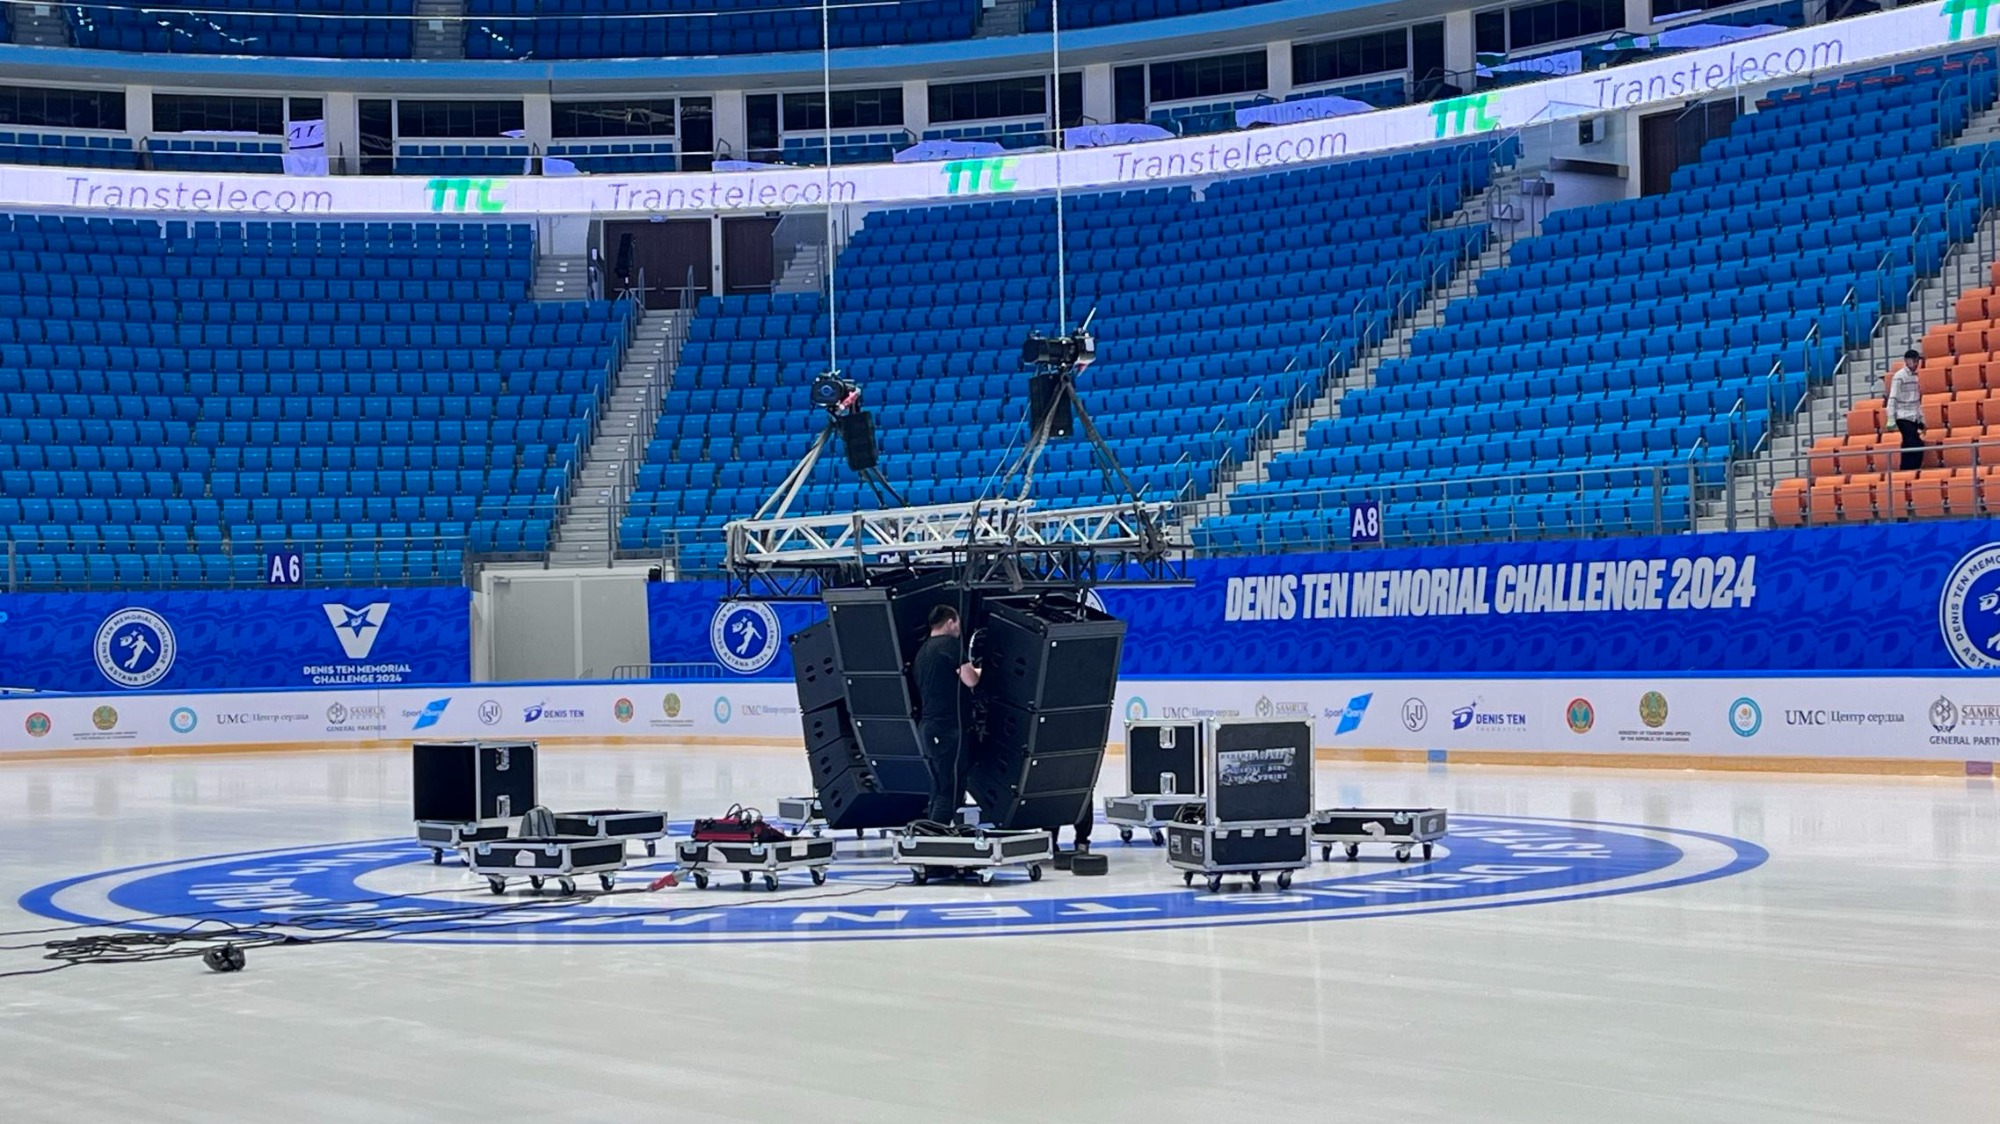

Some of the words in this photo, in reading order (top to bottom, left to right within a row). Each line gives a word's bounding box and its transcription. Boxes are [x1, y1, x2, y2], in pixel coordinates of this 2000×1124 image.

[1595, 40, 1844, 107] Transtelecom
[1113, 131, 1347, 181] Transtelecom
[66, 177, 333, 211] Transtelecom
[608, 179, 856, 211] Transtelecom
[1352, 508, 1378, 537] A8
[271, 555, 300, 582] A6
[1225, 574, 1297, 621] DENIS
[1302, 572, 1349, 619] TEN
[1351, 567, 1489, 618] MEMORIAL
[1494, 559, 1667, 614] CHALLENGE
[1667, 555, 1756, 609] 2024
[1954, 575, 1969, 598] TEN
[1952, 603, 1965, 642] DENIS
[303, 665, 335, 675] DENIS
[336, 665, 355, 674] TEN
[357, 664, 412, 674] MEMORIAL
[313, 674, 374, 684] CHALLENGE
[376, 674, 402, 683] 2024
[216, 713, 249, 724] UMC
[544, 710, 567, 718] DENIS
[569, 710, 584, 718] TEN
[1162, 706, 1189, 718] UMC
[1476, 714, 1504, 724] DENIS
[1506, 714, 1525, 724] TEN
[1785, 710, 1826, 725] UMC
[1831, 711, 1865, 724] Центр
[1867, 713, 1904, 724] сердца
[1930, 736, 1970, 745] GENERAL
[791, 901, 1161, 923] TEN
